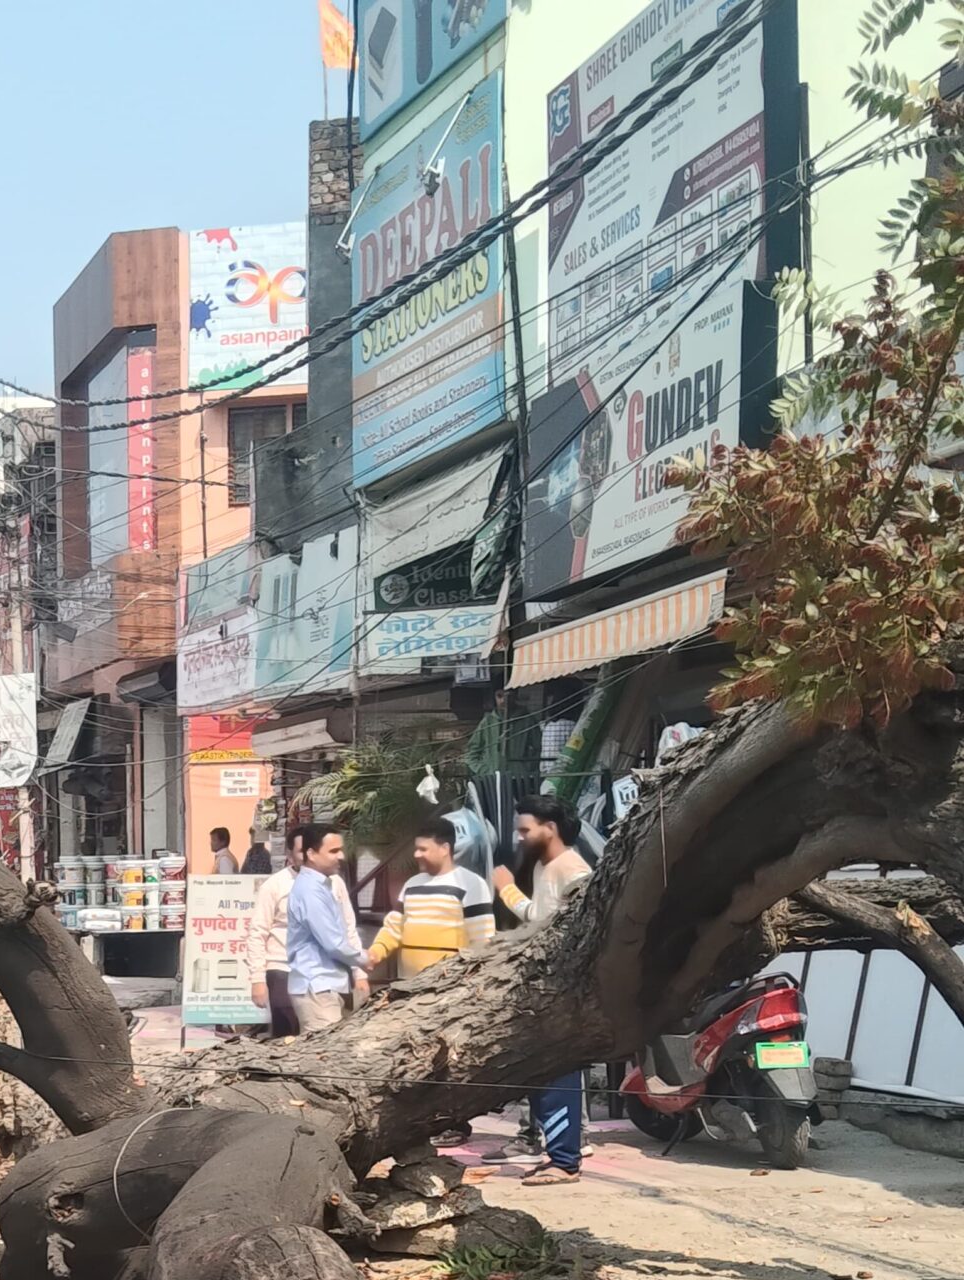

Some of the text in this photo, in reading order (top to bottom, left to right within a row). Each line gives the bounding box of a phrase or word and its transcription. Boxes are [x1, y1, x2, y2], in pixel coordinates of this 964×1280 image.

[586, 40, 619, 91] SHREE
[620, 3, 672, 64] GURUDEV
[359, 143, 492, 302] DEEPALI
[564, 204, 641, 276] SALES & SERVICES
[361, 250, 489, 364] STATIONERS
[627, 360, 723, 462] GUNDEV
[191, 914, 238, 936] गुणदेव
[218, 899, 256, 911] All Type
[201, 941, 225, 953] एण्ड
